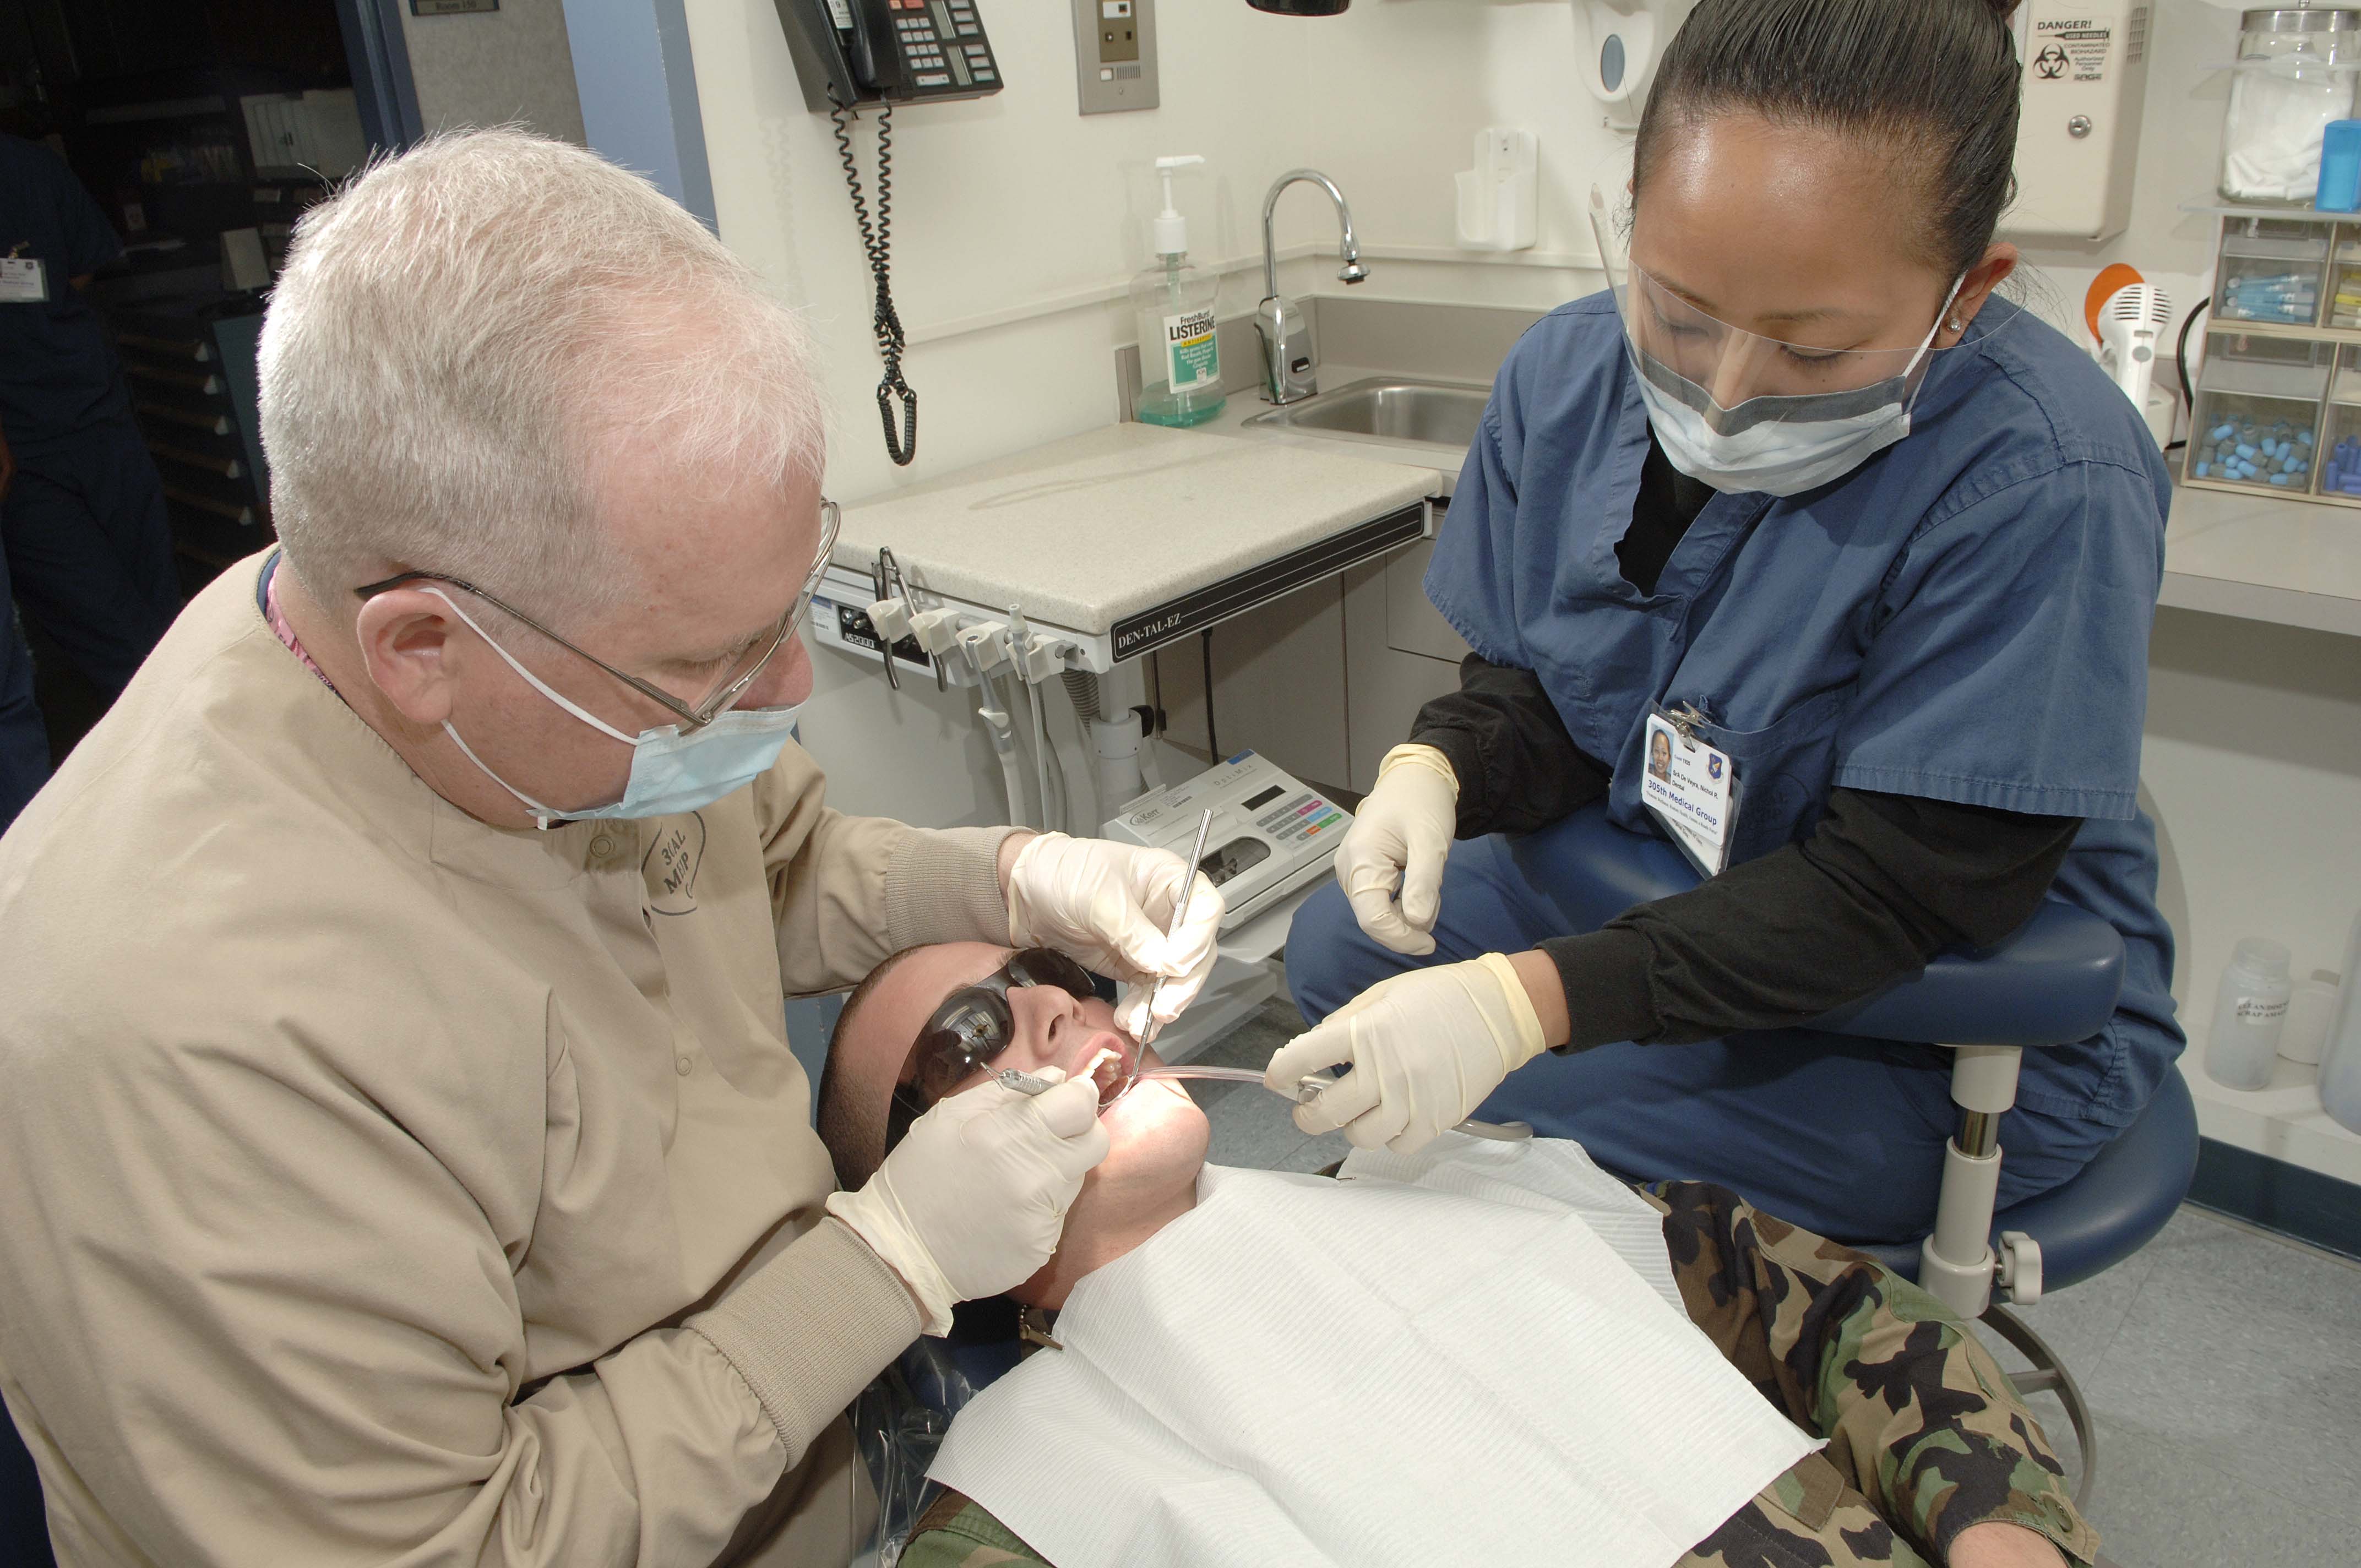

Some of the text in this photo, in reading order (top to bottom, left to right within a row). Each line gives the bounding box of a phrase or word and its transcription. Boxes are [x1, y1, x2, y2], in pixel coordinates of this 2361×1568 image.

[2037, 20, 2092, 30] DANGER!
[1169, 315, 1215, 340] LISTERINE
[1118, 613, 1181, 649] DEN-TAL-EZ
[1672, 780, 1685, 791] Dental
[1648, 780, 1667, 797] 305th
[1669, 791, 1694, 812] Medical
[1696, 807, 1717, 826] Group
[1140, 808, 1160, 820] Kerr
